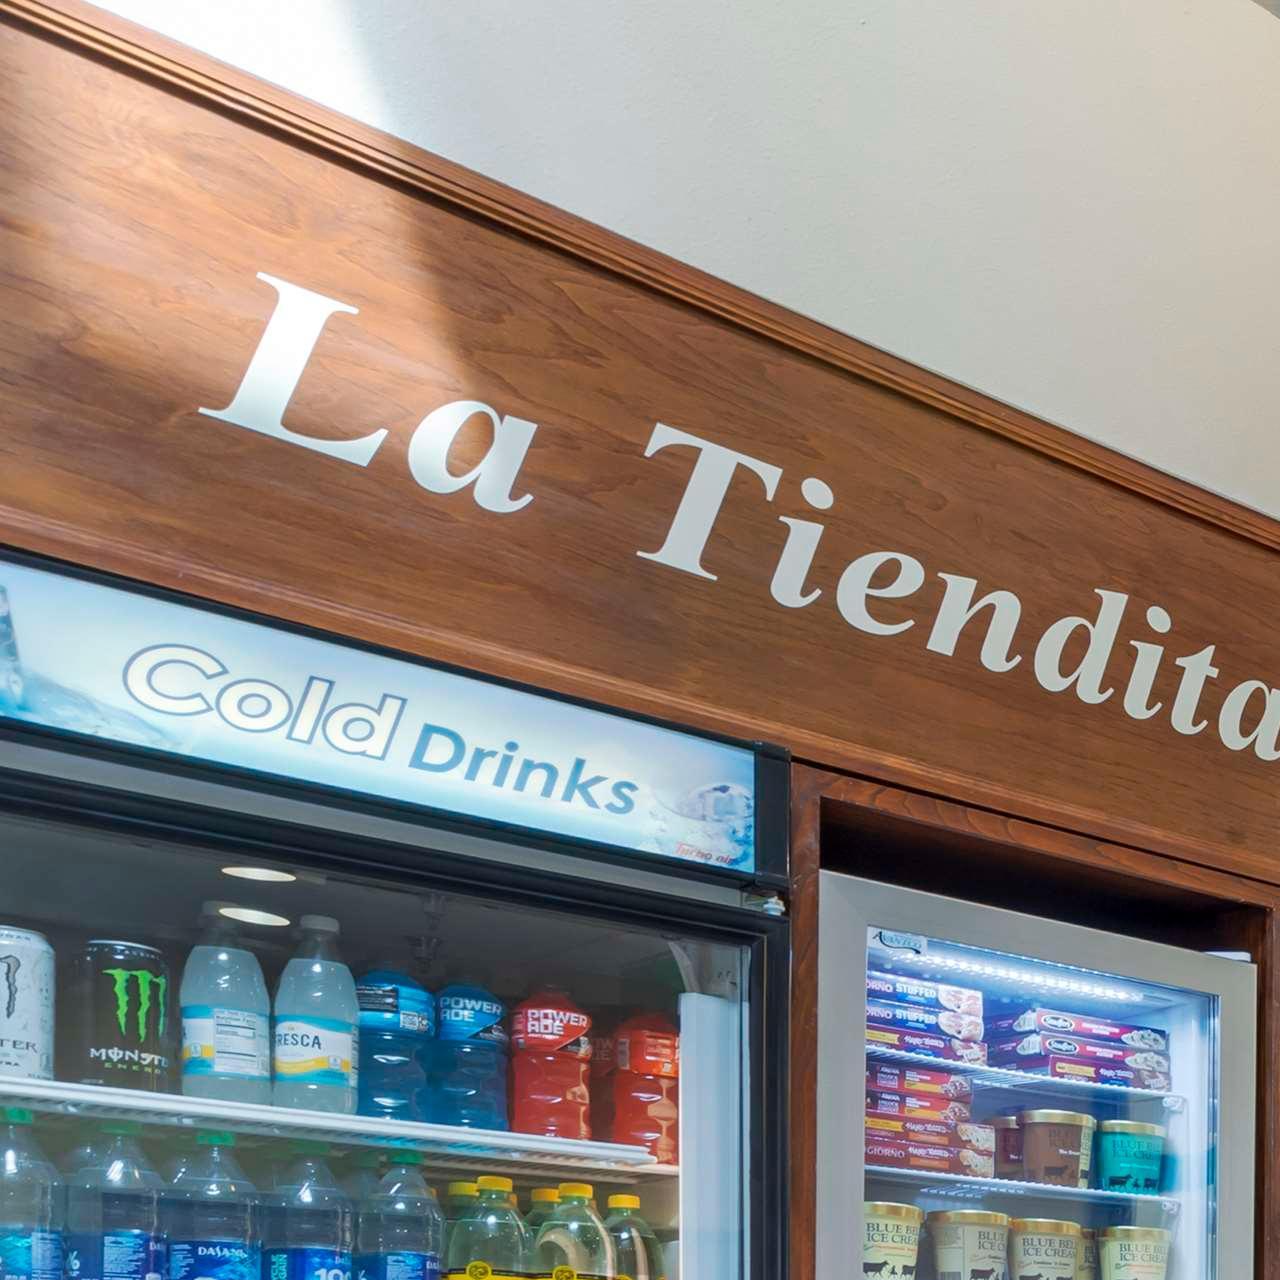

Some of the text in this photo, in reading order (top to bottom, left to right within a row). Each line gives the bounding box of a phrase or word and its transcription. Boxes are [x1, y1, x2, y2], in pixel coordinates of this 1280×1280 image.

[199, 271, 538, 514] La
[121, 642, 639, 818] Cold Drinks
[527, 1008, 589, 1028] POWER
[527, 1021, 565, 1036] ADE
[866, 1222, 903, 1234] BLUE
[866, 1232, 888, 1243] ICE
[1022, 1237, 1057, 1248] BLUE
[1023, 1247, 1042, 1257] ICE
